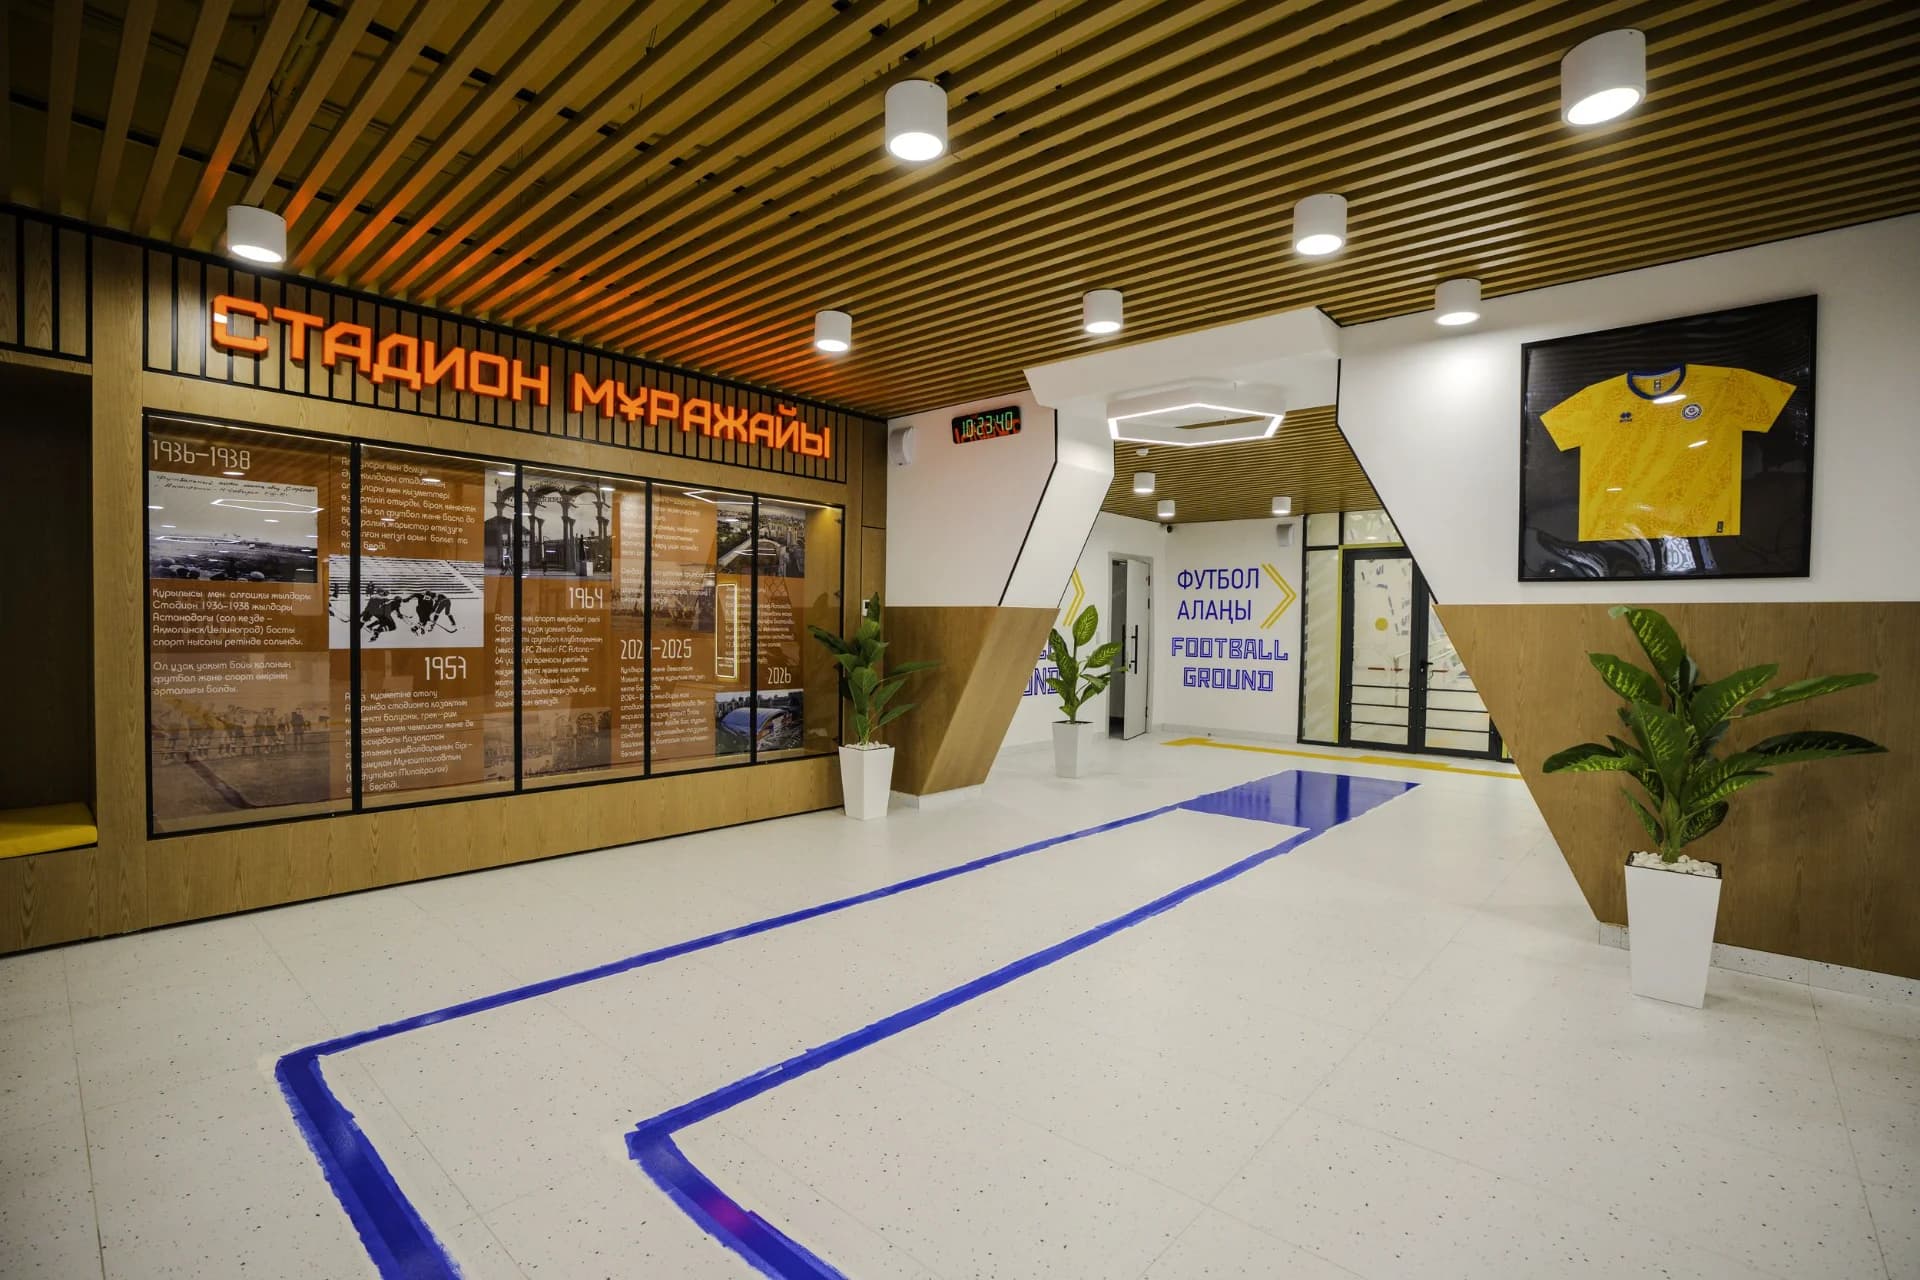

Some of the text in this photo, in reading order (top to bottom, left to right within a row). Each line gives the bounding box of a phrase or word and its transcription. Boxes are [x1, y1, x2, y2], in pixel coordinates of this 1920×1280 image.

[213, 294, 831, 459] СТАДИОН МҰРАЖАЙЫ
[962, 411, 1013, 438] 10:23:40
[1177, 567, 1260, 591] ФУТБОЛ
[569, 587, 603, 609] 1964
[1177, 599, 1252, 624] АЛАҢЫ
[1171, 637, 1289, 661] FOOTBALL
[424, 655, 467, 681] 1957
[768, 667, 792, 685] 2026
[1183, 667, 1274, 692] GROUND
